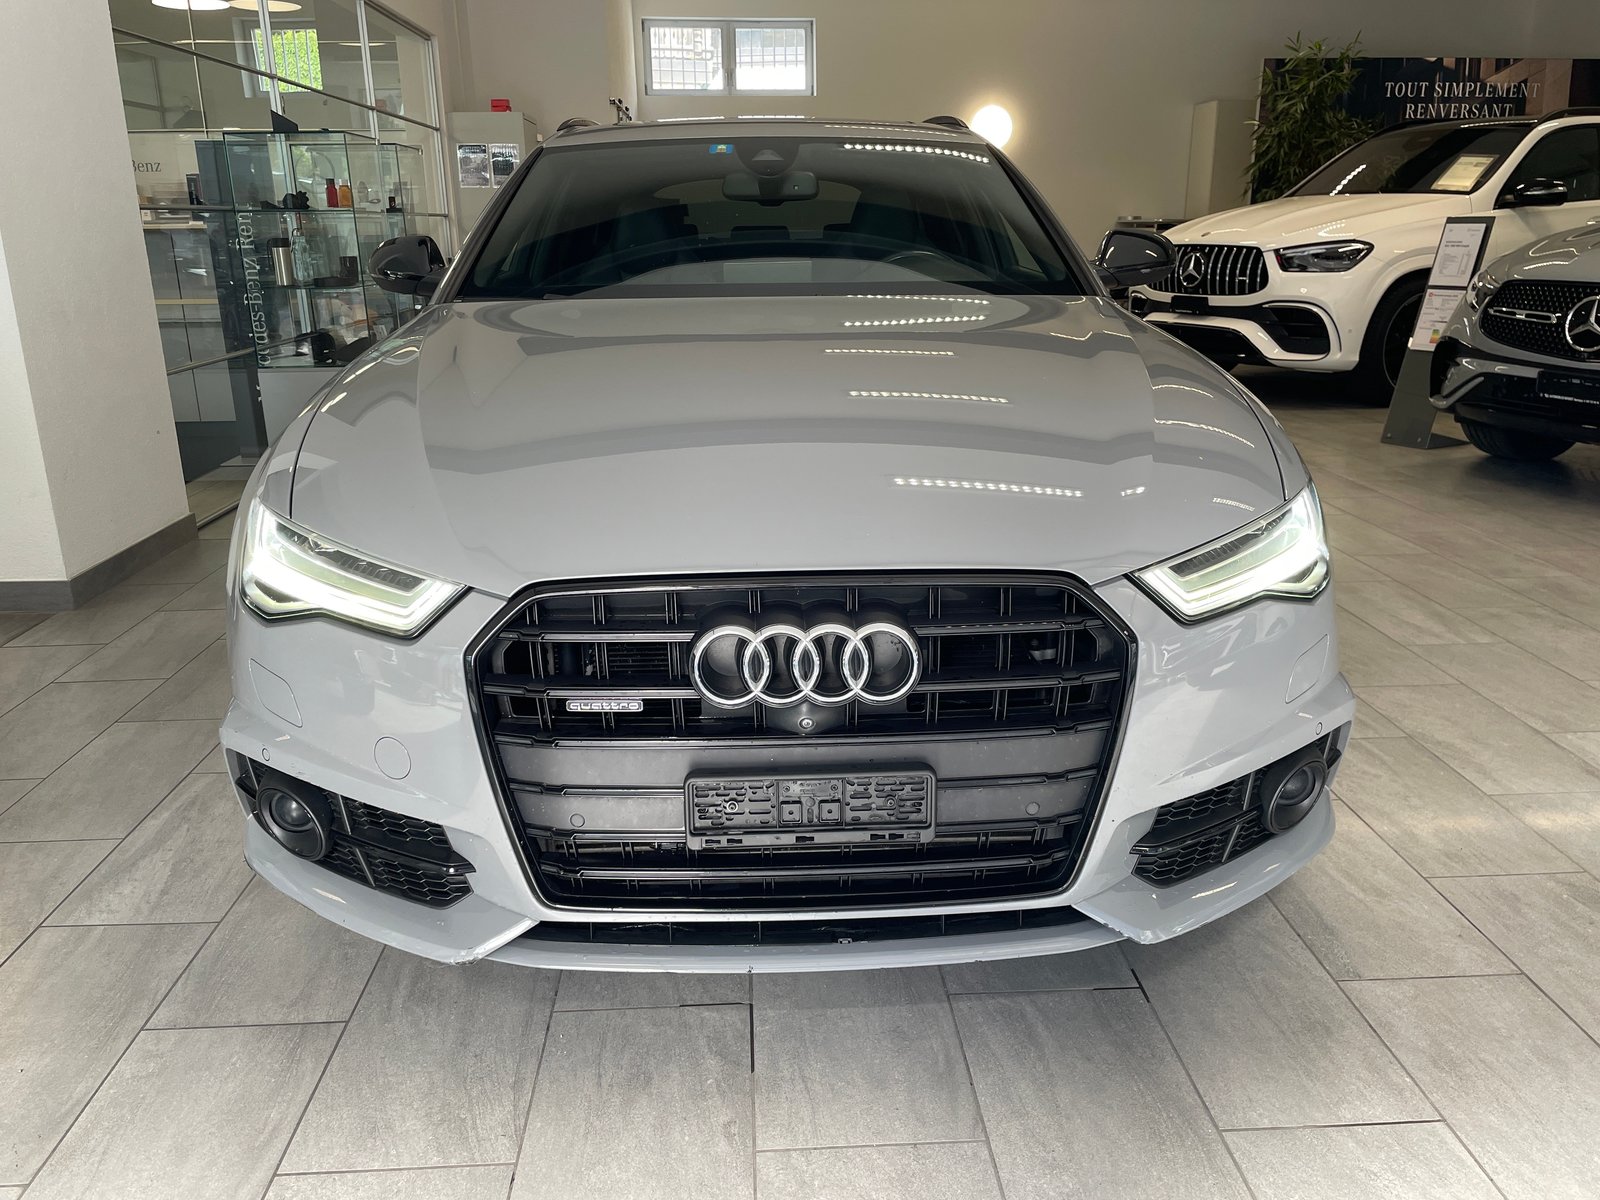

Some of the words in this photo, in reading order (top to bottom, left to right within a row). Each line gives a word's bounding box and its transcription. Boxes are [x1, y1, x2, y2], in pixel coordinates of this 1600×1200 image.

[1384, 82, 1429, 98] TOUT
[1434, 82, 1541, 98] SIMPLEMENT
[1405, 103, 1513, 119] RENVERSANT
[568, 701, 640, 711] quattro
